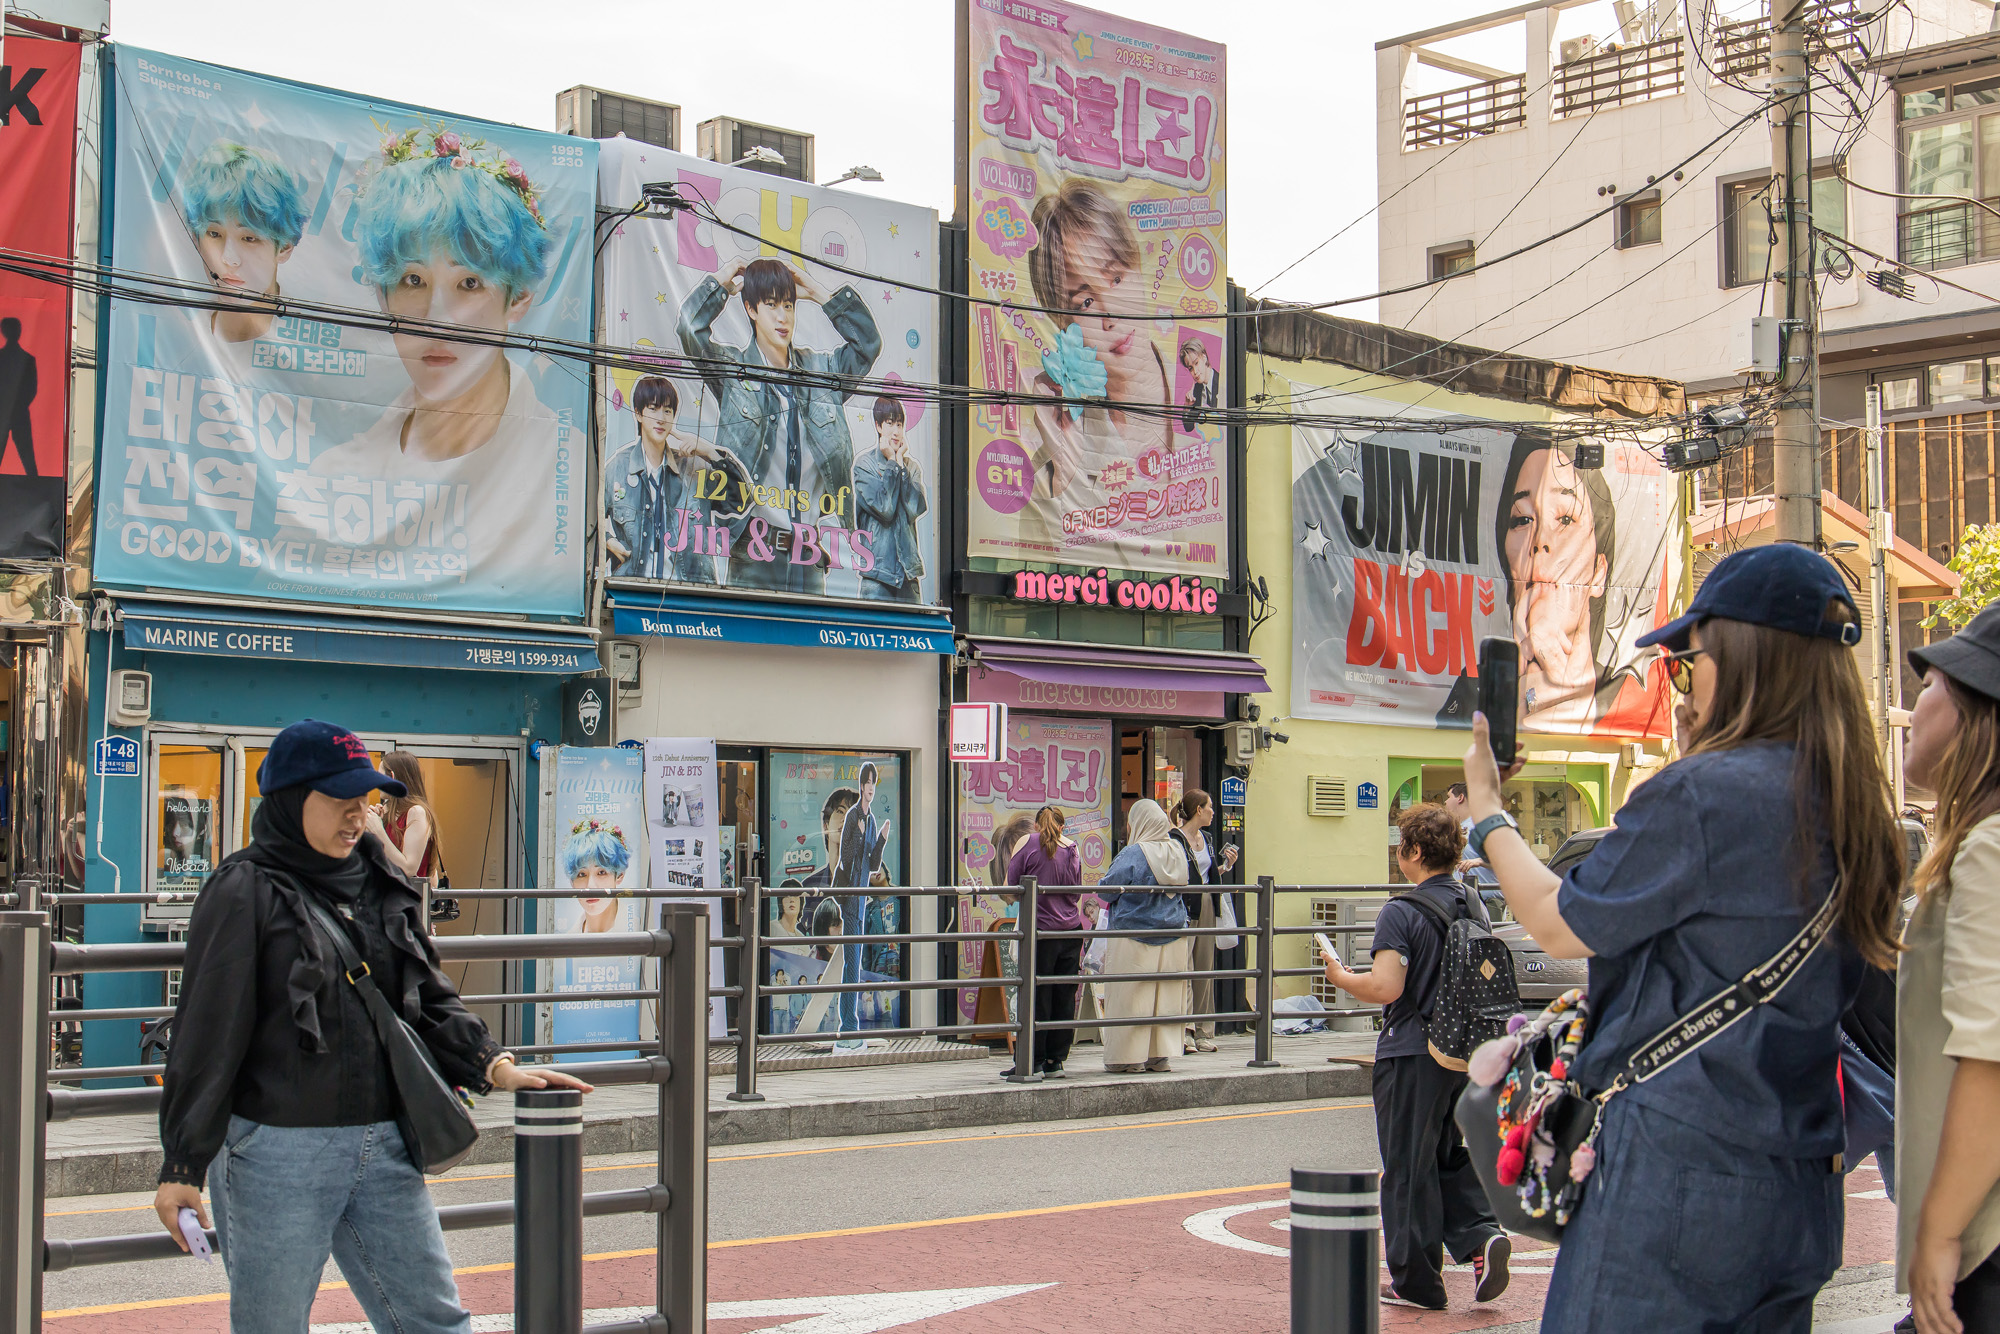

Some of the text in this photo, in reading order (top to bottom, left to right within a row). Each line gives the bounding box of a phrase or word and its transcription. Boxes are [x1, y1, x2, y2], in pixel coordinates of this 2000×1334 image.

[1100, 31, 1116, 41] JIMIN
[1116, 35, 1133, 45] CAFE
[1134, 39, 1153, 50] EVENT
[1115, 47, 1155, 72] 2025年
[137, 58, 222, 92] Born to be a
[138, 71, 212, 100] Superstar
[551, 145, 584, 157] 1995
[551, 156, 584, 168] 1230
[982, 163, 1033, 193] VOL.1013
[1130, 198, 1209, 215] FOREVER AND EVER
[1139, 219, 1159, 228] WITH
[1160, 217, 1178, 227] JIMIN
[824, 241, 845, 258] JIN
[1183, 246, 1211, 276] 06
[980, 270, 1017, 292] キラキラ
[1180, 297, 1218, 314] キラキラ
[276, 316, 343, 348] 김태형
[253, 343, 366, 376] 많이 보라해
[128, 366, 316, 464] 태형아
[1440, 439, 1458, 451] ALWAYS
[554, 407, 573, 556] WELCOME BACK
[987, 465, 1023, 487] 611
[123, 446, 469, 548] 전역 축하해!
[692, 468, 851, 517] 12 years of
[1341, 440, 1482, 565] JIMIN
[663, 507, 876, 572] Jin & BTS
[120, 521, 468, 584] GOOD BYE! 흑복의 추억
[1186, 542, 1216, 563] JIMIN
[1400, 549, 1427, 579] IS
[267, 582, 439, 602] LOVE FROM CHINESE FANS & CHINA VBAR
[1014, 567, 1219, 614] merci cookie
[641, 617, 723, 638] Bom market
[1346, 557, 1479, 678] BACK
[144, 627, 294, 654] MARINE COFFEE
[819, 629, 936, 651] 050-7017-73461
[465, 647, 579, 667] 가맹문의 1599-9341
[1345, 670, 1385, 685] WE MISSED YOU
[1019, 678, 1178, 710] merci cookie
[664, 754, 680, 762] Debut
[953, 743, 987, 753] 메르시쿠키
[660, 765, 703, 779] JIN & BTS
[785, 763, 885, 780] BTS ARY
[1223, 781, 1244, 793] 11-44
[1359, 786, 1377, 797] 11-42
[1085, 841, 1102, 859] 06
[577, 965, 620, 984] 태형아
[1526, 962, 1542, 972] KIA
[559, 1001, 583, 1011] GOOD
